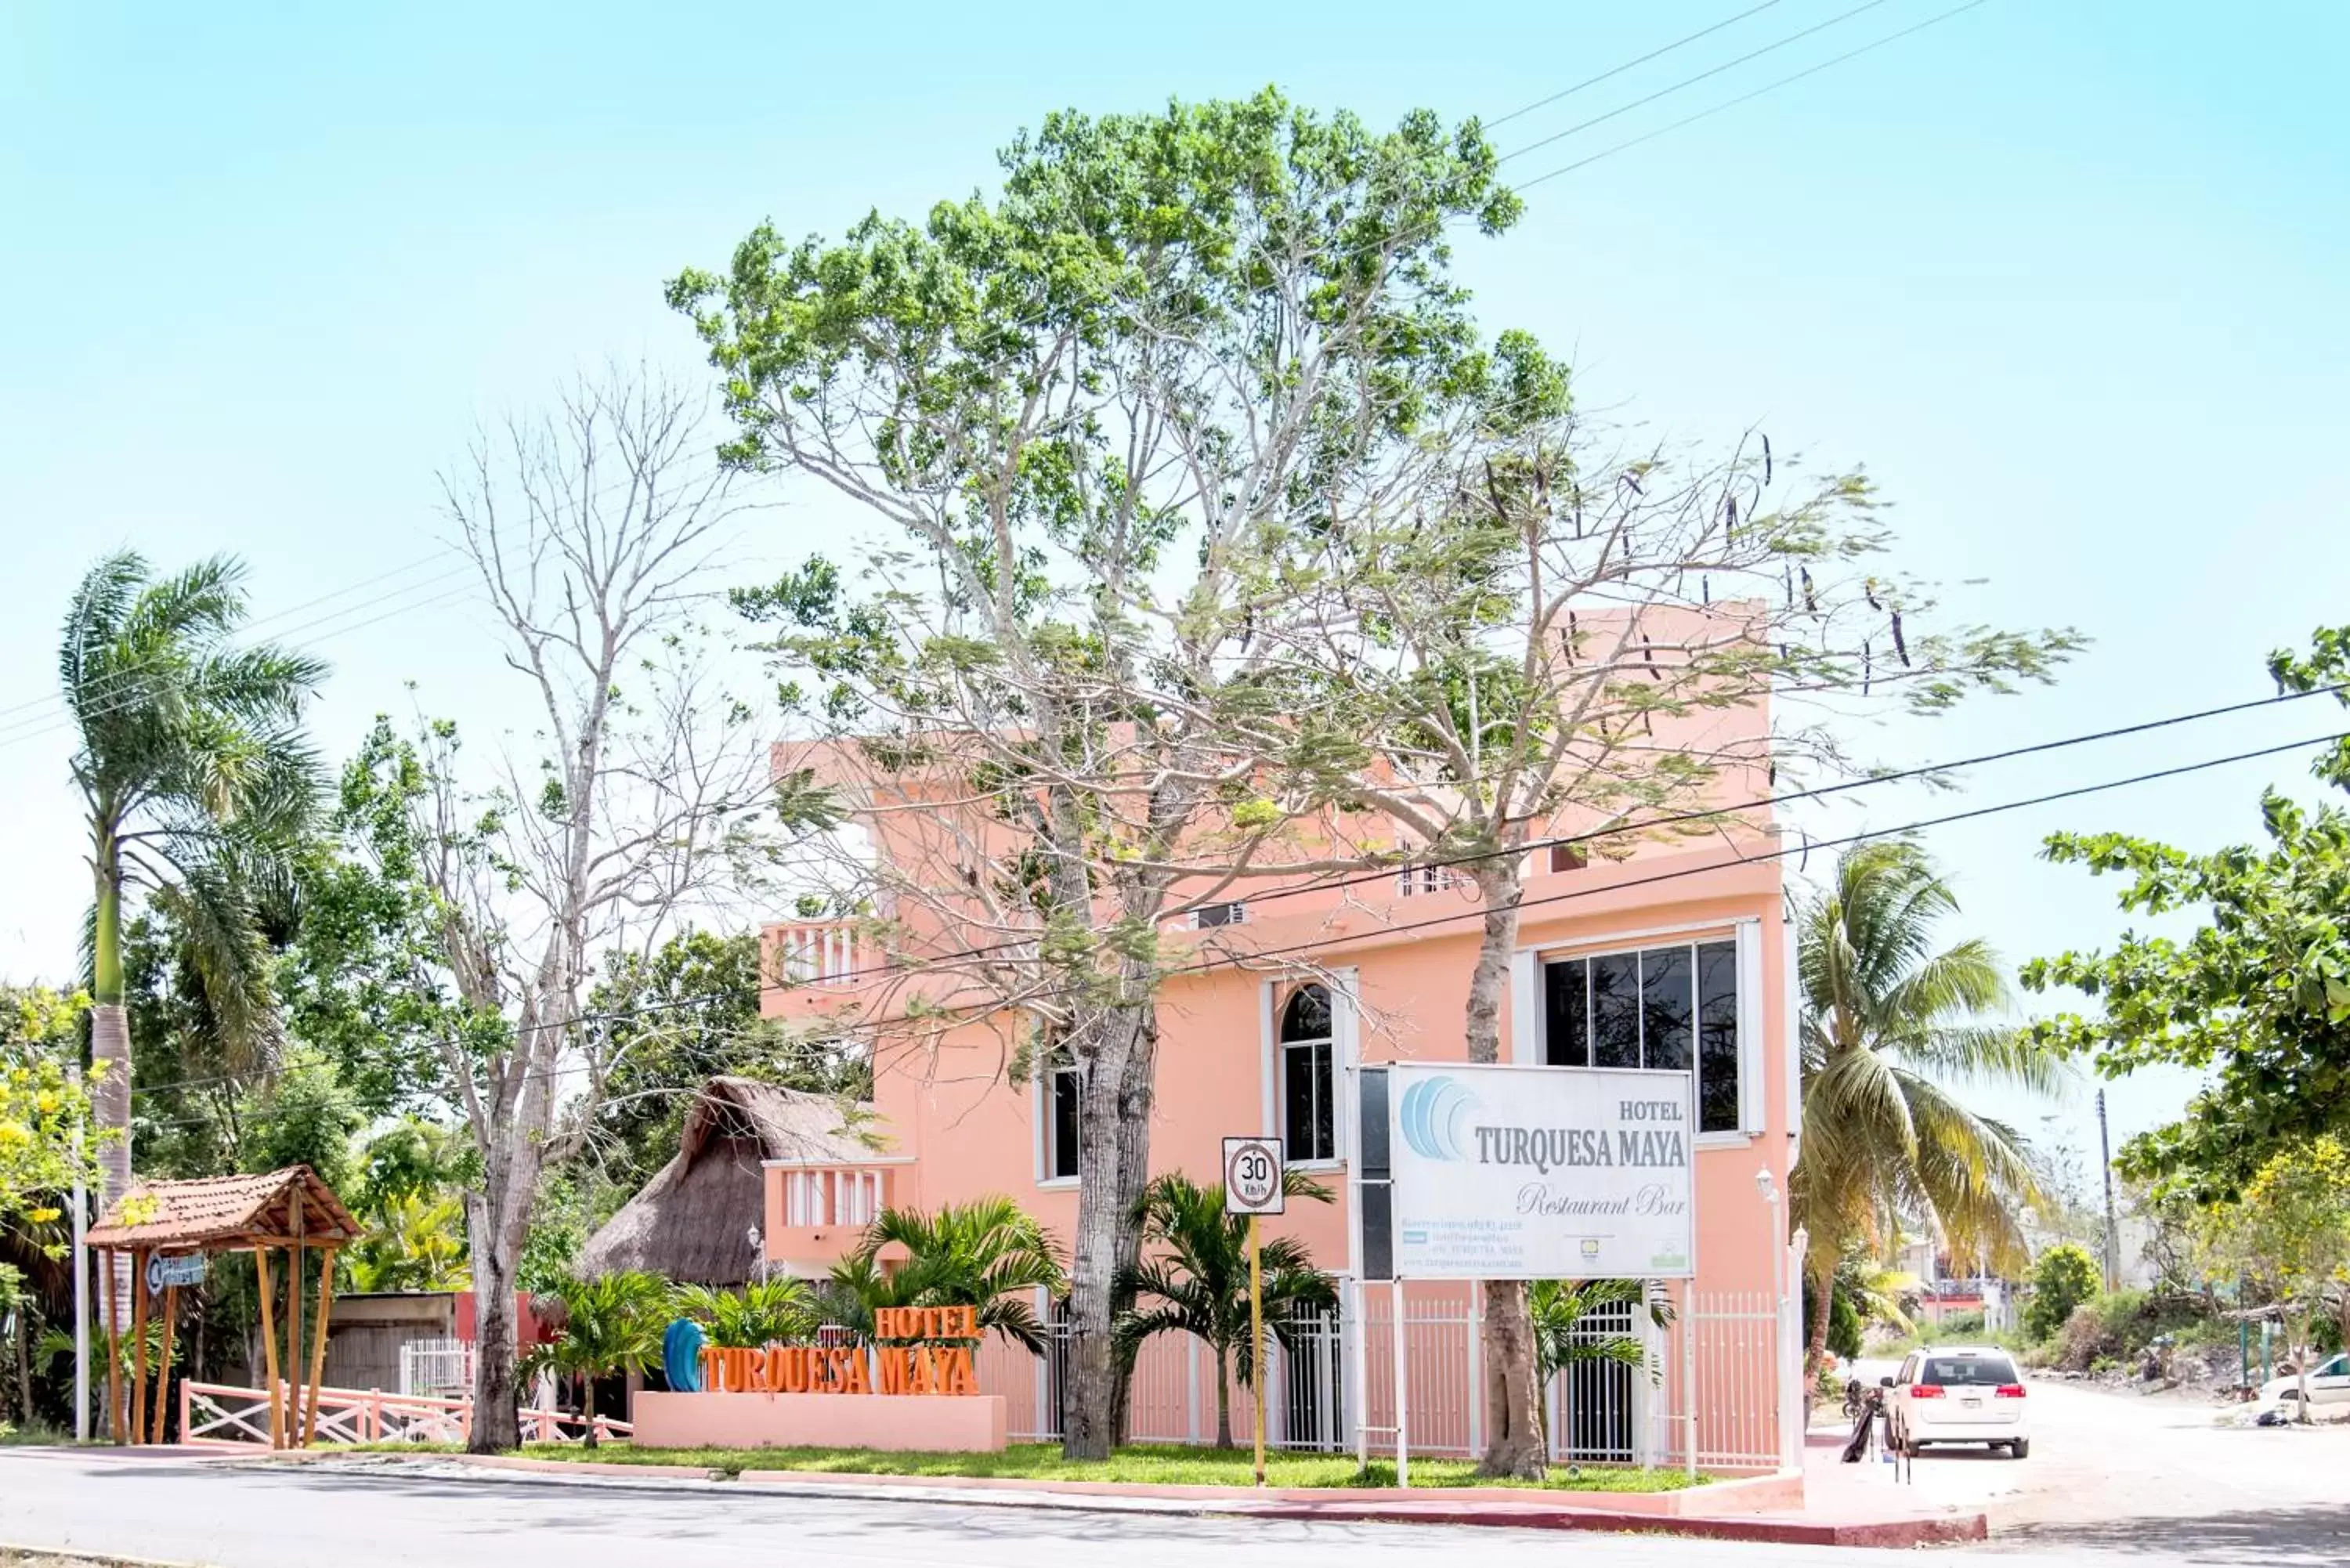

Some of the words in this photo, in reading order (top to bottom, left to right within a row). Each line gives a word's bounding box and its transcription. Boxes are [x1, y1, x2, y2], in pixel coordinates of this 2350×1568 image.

[1619, 1101, 1682, 1120] HOTEL
[1475, 1126, 1613, 1175] TURQUESA
[1618, 1130, 1685, 1167] MAYA
[1242, 1156, 1266, 1180] 30
[1517, 1182, 1629, 1215] Restaurant
[1635, 1183, 1685, 1216] Bar
[875, 1306, 985, 1338] HOTEL
[702, 1346, 875, 1394] TURQUESA
[879, 1347, 979, 1395] MAYA
